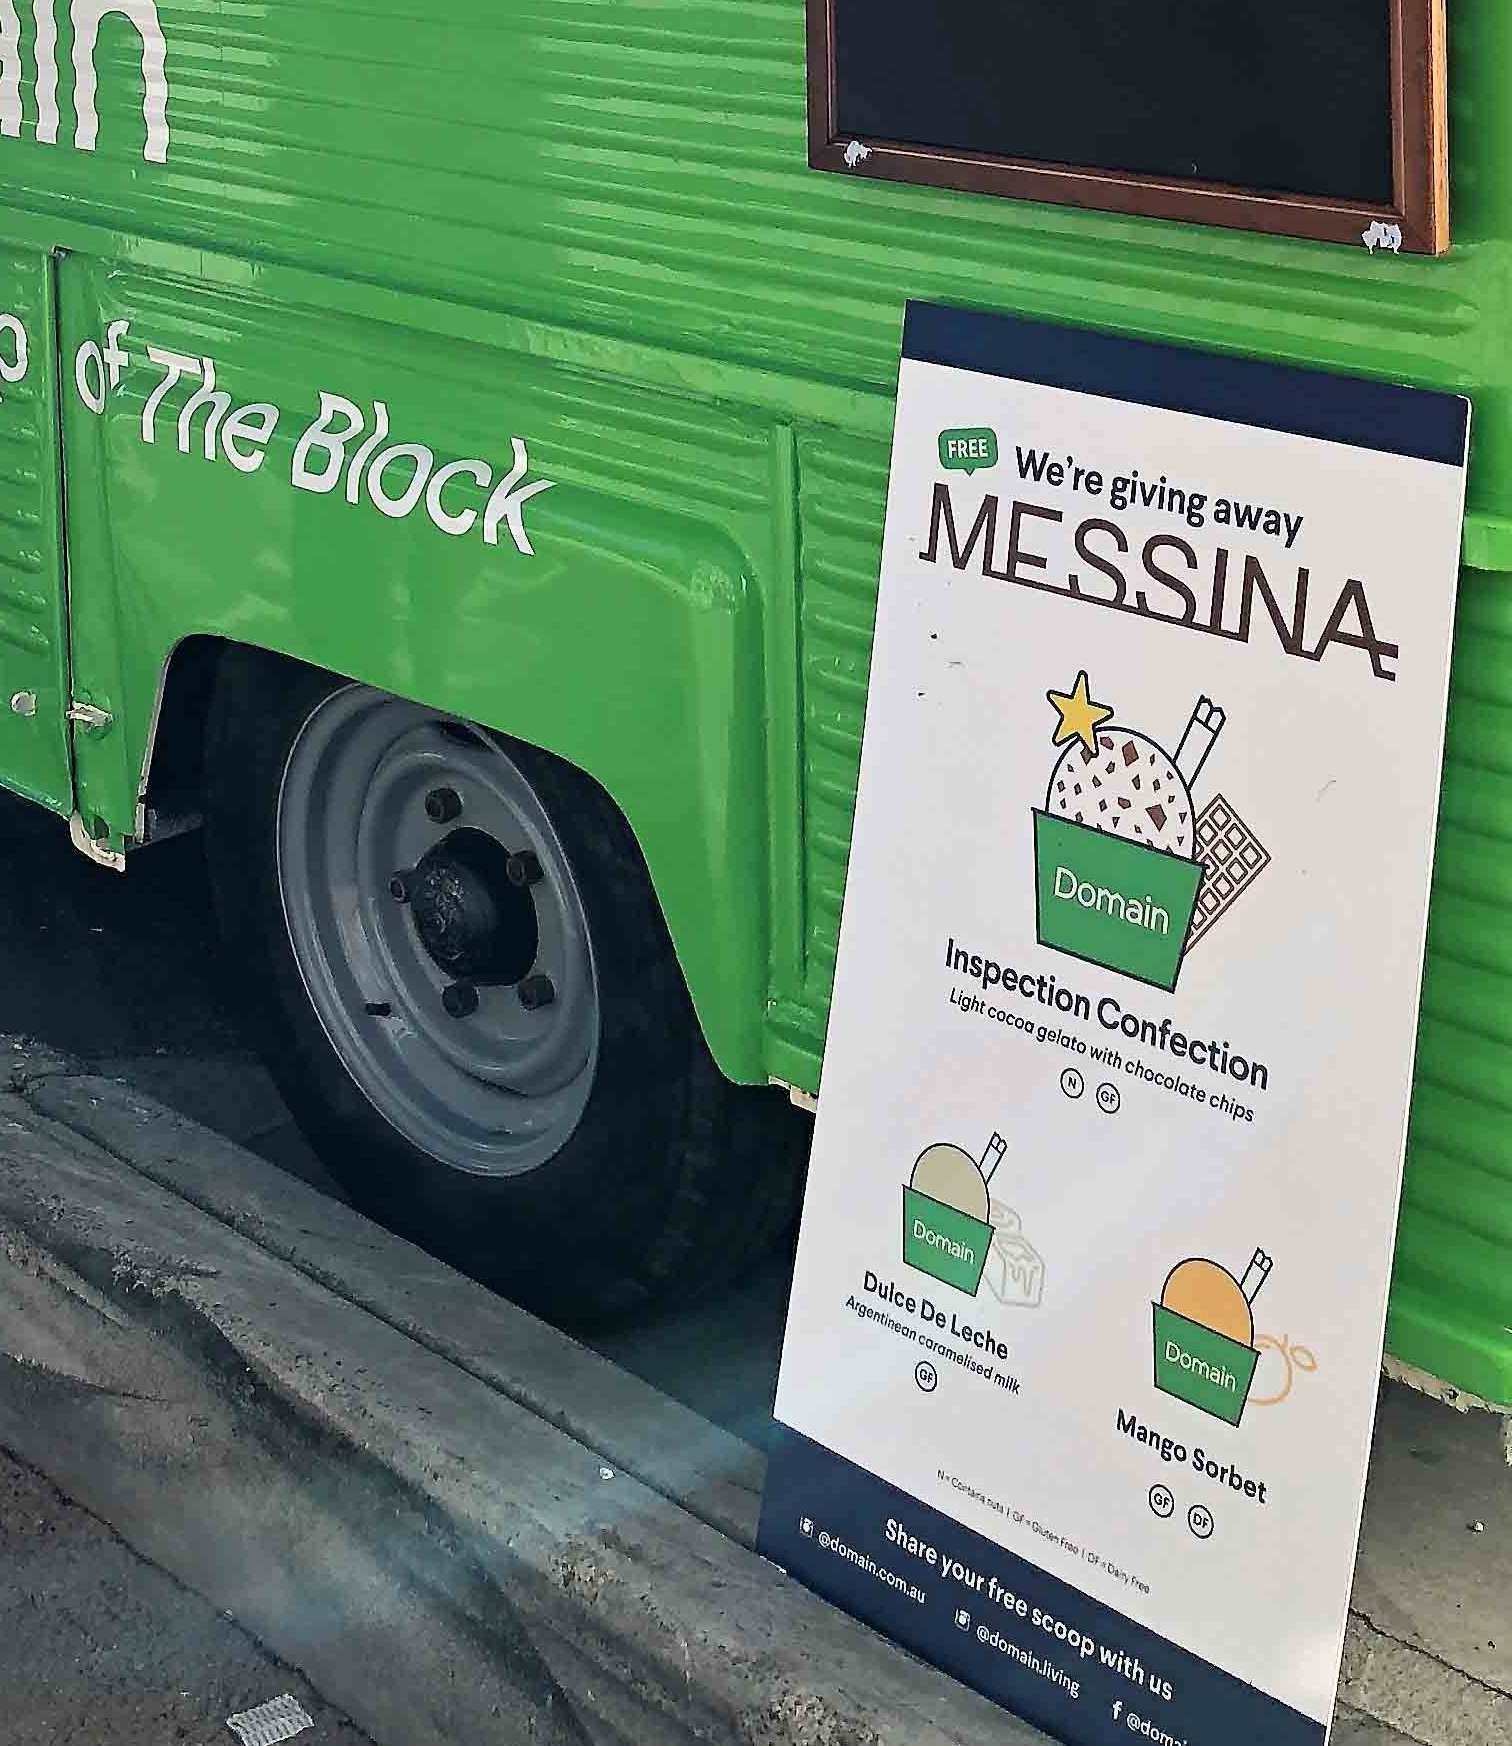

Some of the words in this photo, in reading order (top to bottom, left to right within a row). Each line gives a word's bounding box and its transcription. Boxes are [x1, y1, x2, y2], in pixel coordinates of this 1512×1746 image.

[74, 318, 132, 415] of
[141, 345, 280, 475] The
[290, 388, 556, 558] Block
[946, 437, 989, 459] FREE
[1015, 444, 1104, 496] We're
[1111, 470, 1207, 527] giving
[1213, 498, 1304, 549] away
[918, 482, 1399, 682] MESSINA
[1053, 866, 1170, 935] Domain
[945, 937, 1090, 1021] Inspection
[1097, 997, 1269, 1090] Confection
[949, 986, 986, 1016] Light
[987, 1004, 1035, 1034] cocoa
[1037, 1023, 1087, 1055] gelato
[1090, 1042, 1122, 1070] with
[1125, 1059, 1207, 1104] chocolate
[1209, 1090, 1254, 1123] chips
[913, 1219, 975, 1265] Domain
[845, 1295, 917, 1341] Argentinean
[918, 1334, 994, 1380] caramelised
[994, 1372, 1021, 1395] milk
[863, 1270, 917, 1313] Dulce
[920, 1299, 946, 1329] De
[950, 1314, 1009, 1360] Leche
[1165, 1341, 1237, 1392] Domain
[1116, 1407, 1187, 1462] Mango
[1192, 1447, 1267, 1504] Sorbet
[818, 1531, 927, 1604] @domain.com.au
[885, 1518, 939, 1565] Share
[941, 1553, 985, 1593] your
[988, 1576, 1028, 1617] free
[1031, 1607, 1095, 1656] scoop
[1099, 1644, 1145, 1686] with
[1149, 1674, 1173, 1701] us
[977, 1624, 1081, 1699] @domain.living
